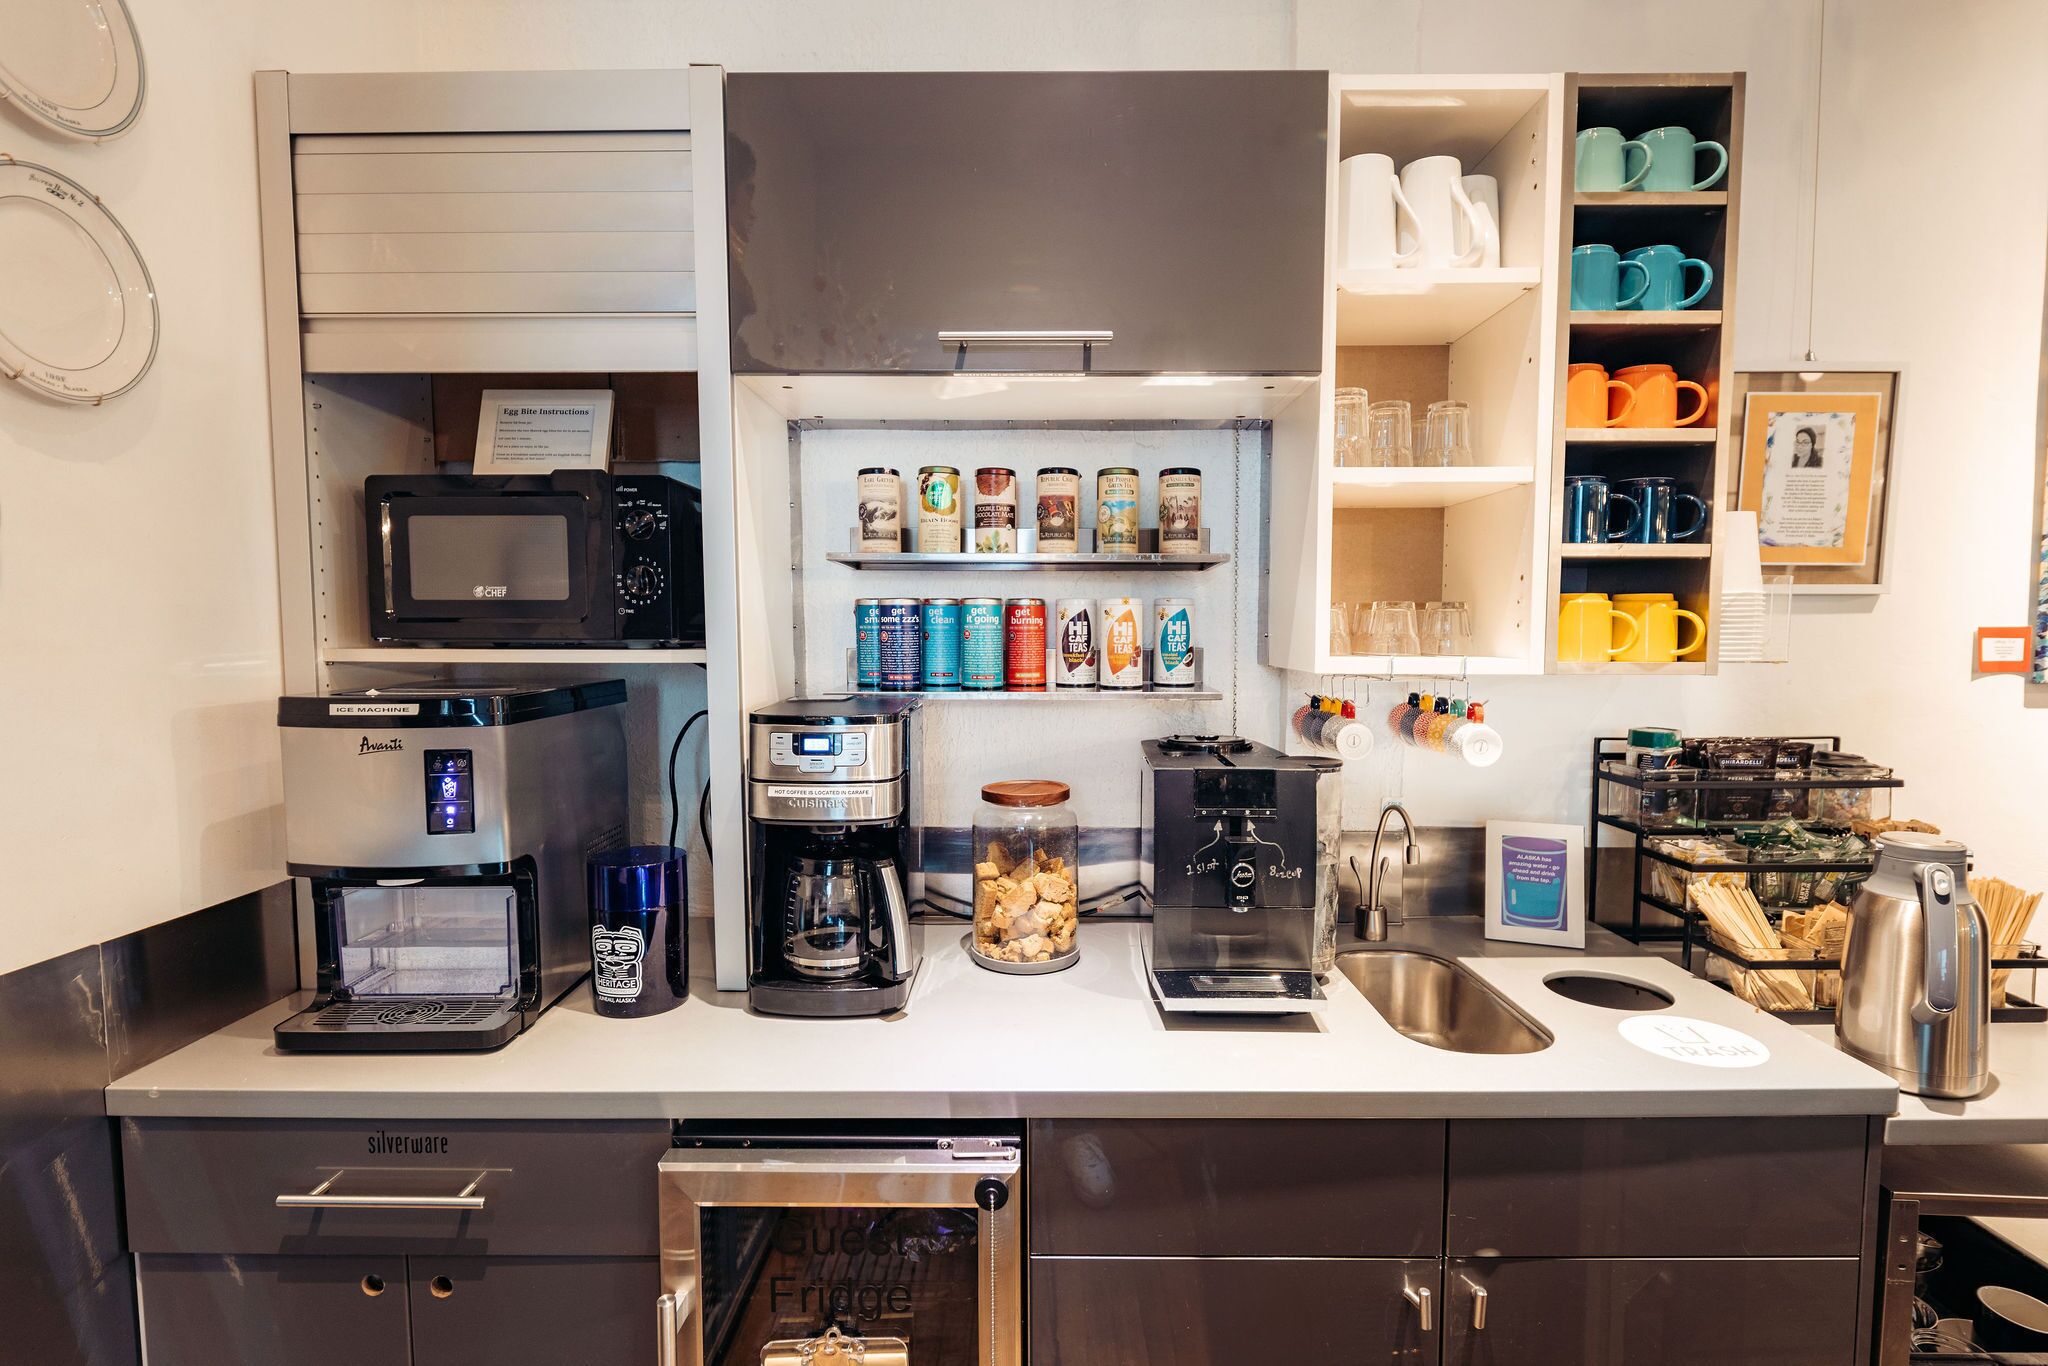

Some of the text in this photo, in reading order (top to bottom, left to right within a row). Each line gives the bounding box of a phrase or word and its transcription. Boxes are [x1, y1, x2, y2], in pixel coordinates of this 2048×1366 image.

[504, 408, 518, 416] Egg
[869, 608, 879, 616] ge
[891, 608, 906, 616] get
[929, 608, 944, 616] get
[971, 607, 987, 615] get
[1015, 608, 1030, 617] get
[974, 616, 999, 625] going
[1011, 616, 1044, 625] burning
[1069, 621, 1088, 635] Hi
[1114, 621, 1133, 636] Hi
[1167, 621, 1187, 634] Hi
[1069, 643, 1088, 652] TEAS
[1114, 644, 1133, 653] TEAS
[1168, 642, 1187, 652] TEAS
[359, 736, 404, 754] Avanti
[598, 978, 636, 988] HERITAGE
[1663, 1045, 1758, 1056] TRASH
[368, 1130, 448, 1154] silverware
[776, 1216, 908, 1256] Guest
[770, 1277, 912, 1321] Fridge
